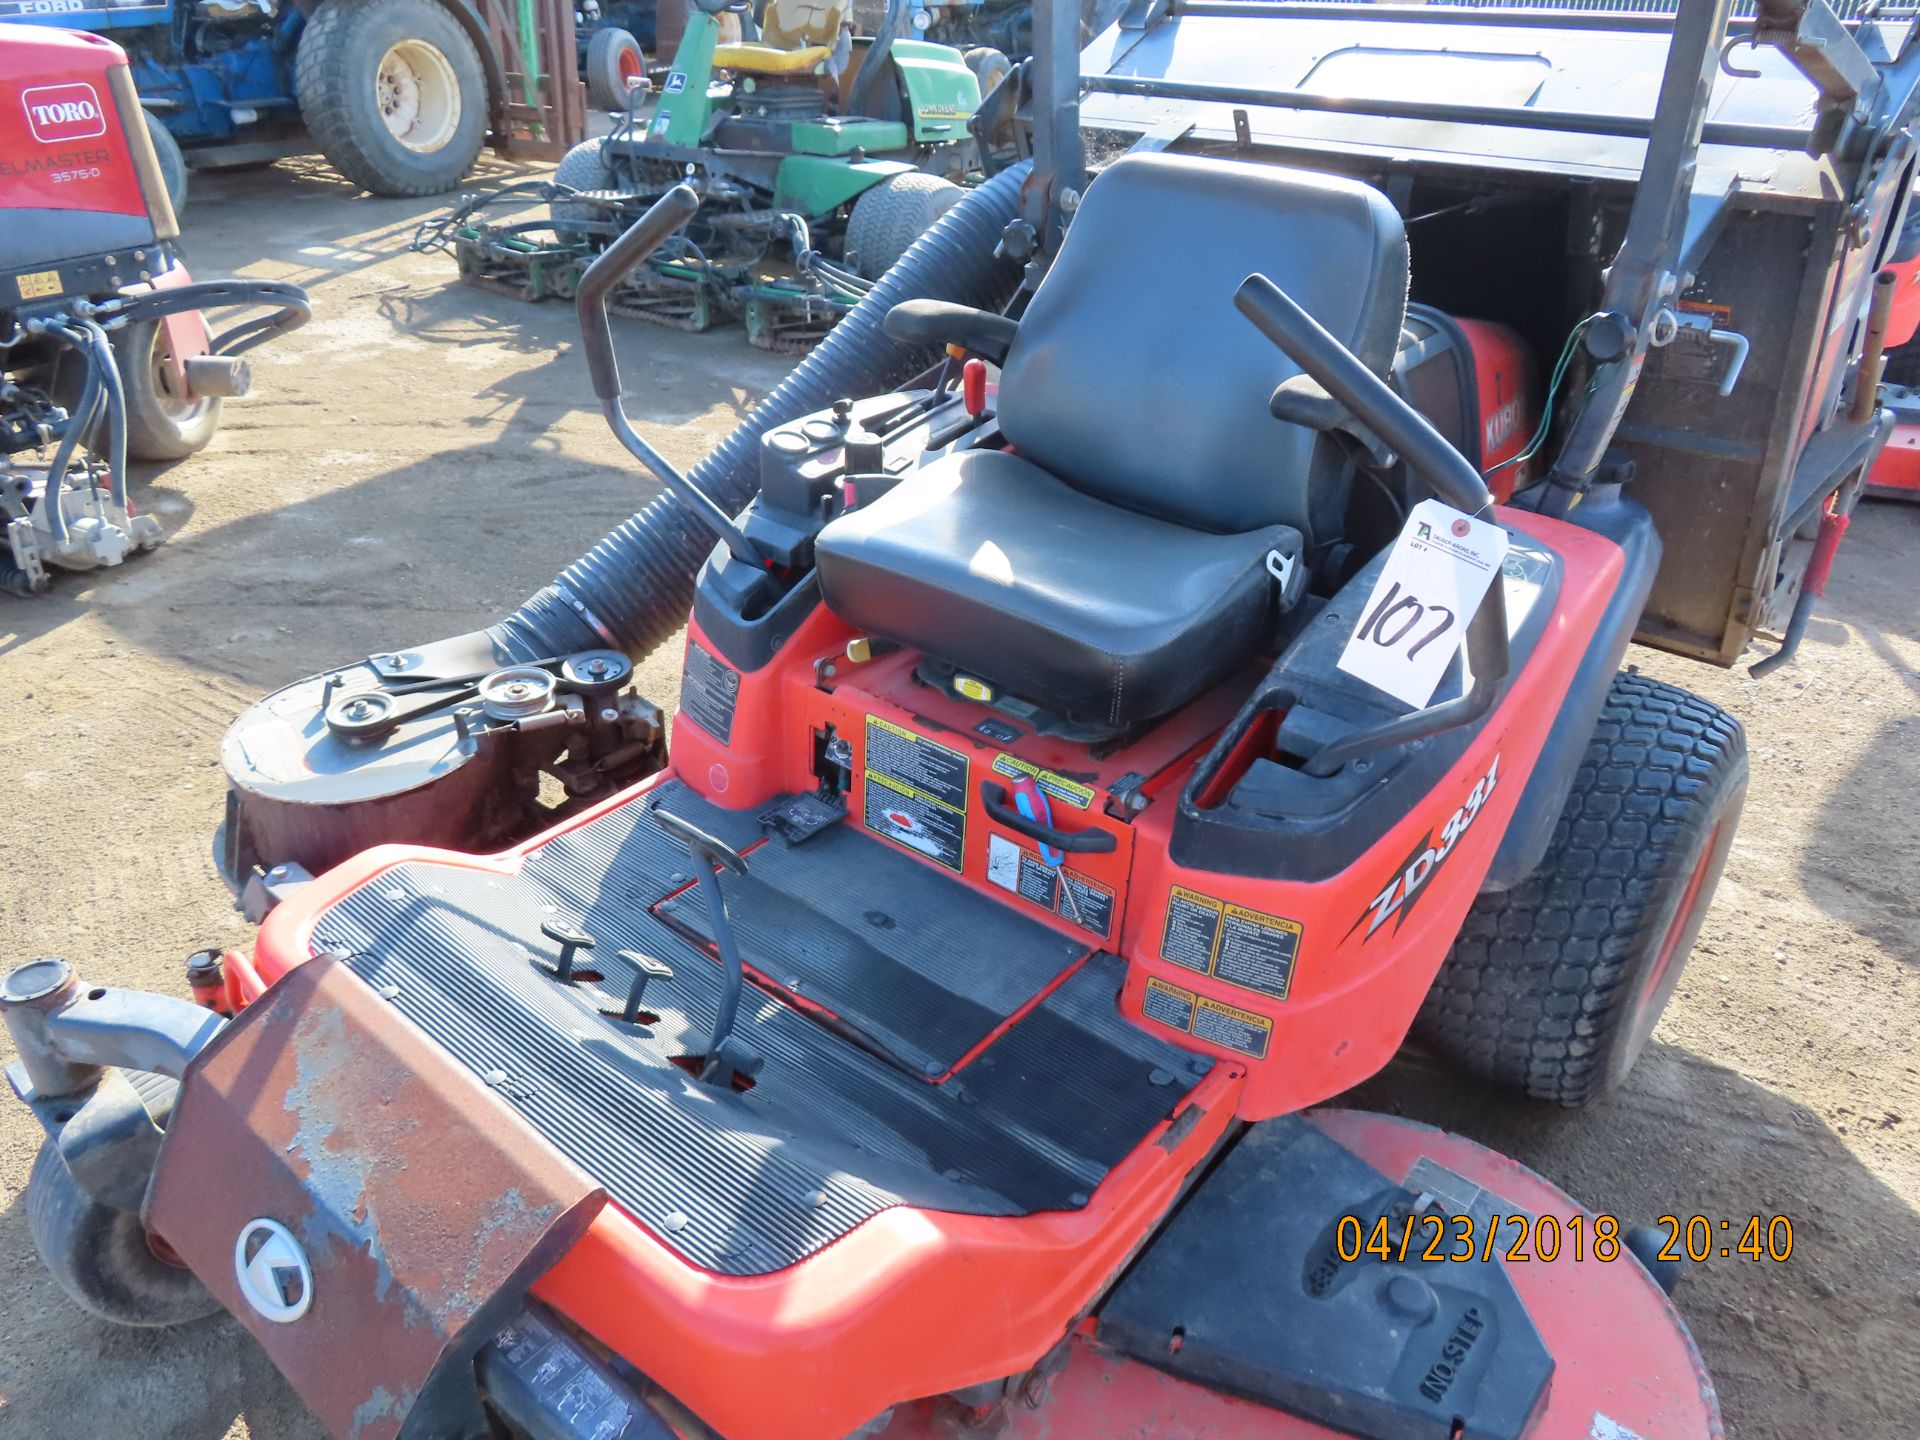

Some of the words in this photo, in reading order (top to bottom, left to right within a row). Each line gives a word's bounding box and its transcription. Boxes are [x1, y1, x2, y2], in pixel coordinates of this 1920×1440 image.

[20, 0, 84, 14] FORD
[32, 100, 96, 125] TORO
[1410, 541, 1422, 550] LOT
[1357, 581, 1455, 662] 107
[879, 721, 906, 736] CAUTION
[1005, 757, 1037, 774] CAUTION
[1366, 752, 1500, 938] ZD331
[1182, 890, 1218, 908] WARNING
[1236, 908, 1293, 931] ADVERTENCIA
[1156, 982, 1192, 1000] WARNING
[1210, 1001, 1265, 1027] ADVERTENCIA
